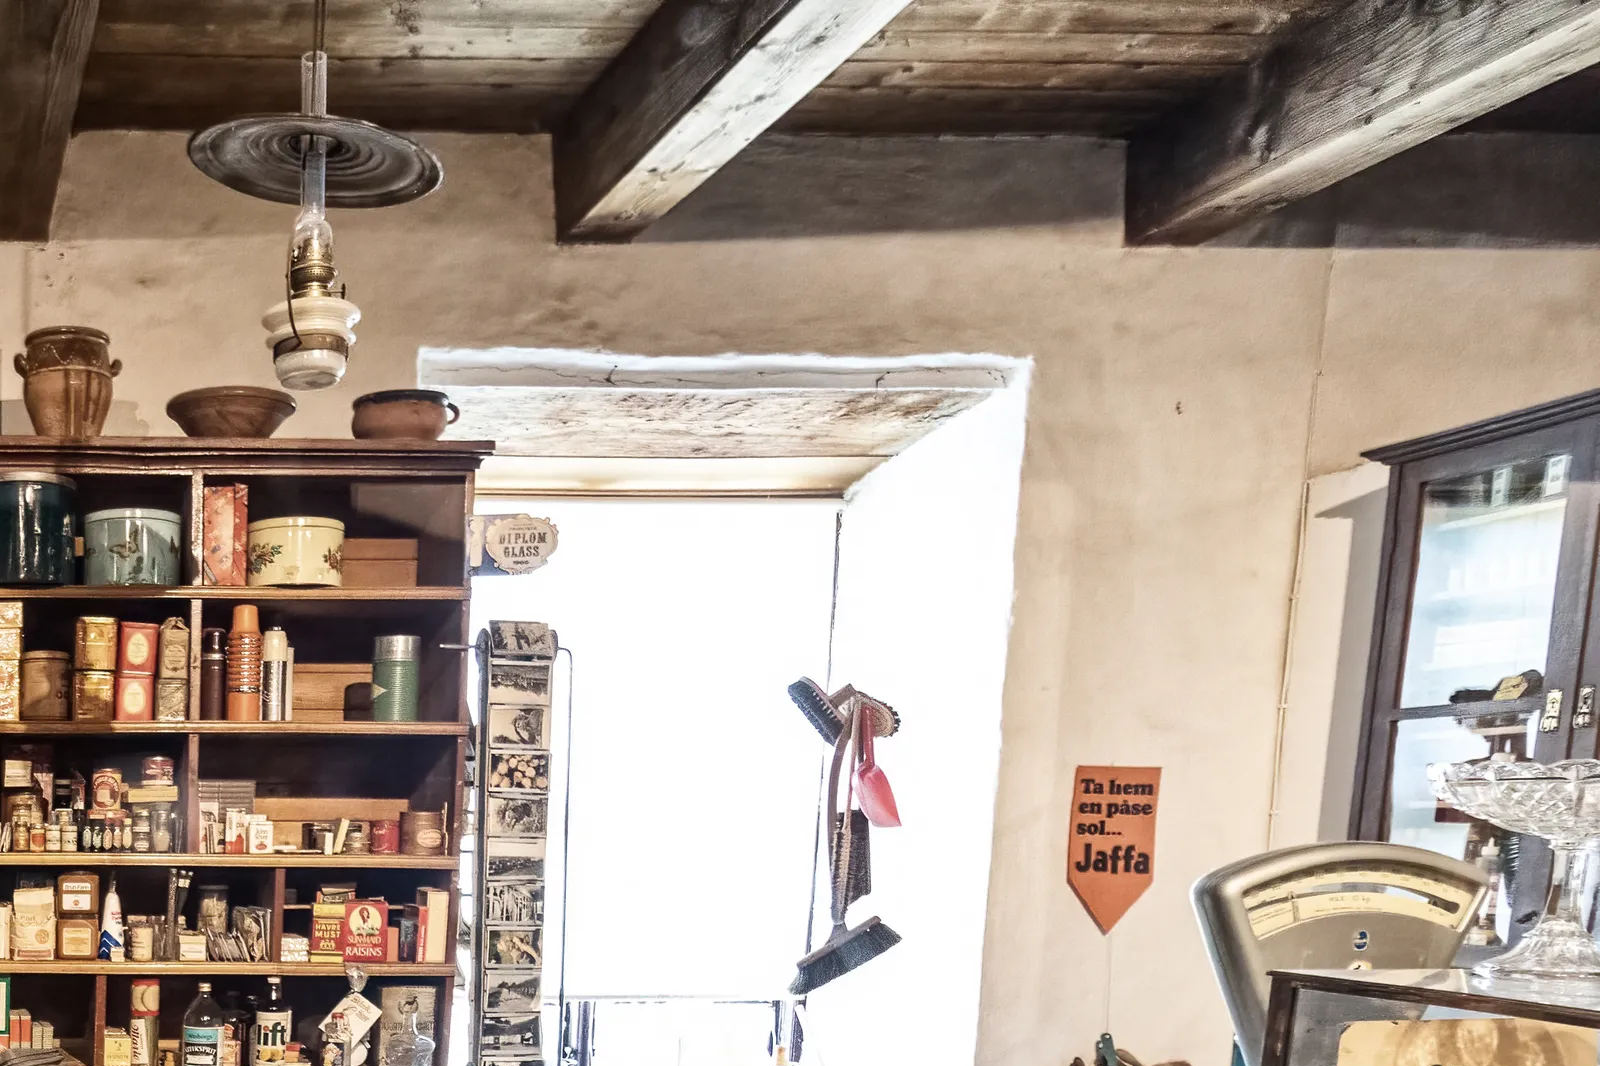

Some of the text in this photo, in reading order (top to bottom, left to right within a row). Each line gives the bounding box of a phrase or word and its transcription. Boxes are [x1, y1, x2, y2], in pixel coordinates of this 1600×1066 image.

[499, 532, 548, 544] DIPLOM
[504, 546, 540, 558] GLASS
[1080, 778, 1154, 796] Ta hem
[1078, 800, 1153, 818] en påse
[1076, 820, 1123, 836] sol...
[1075, 843, 1150, 875] Jaffa
[315, 923, 341, 931] HAVRE
[315, 931, 342, 939] MUST
[345, 947, 383, 957] RAISINS
[257, 1022, 287, 1046] lift
